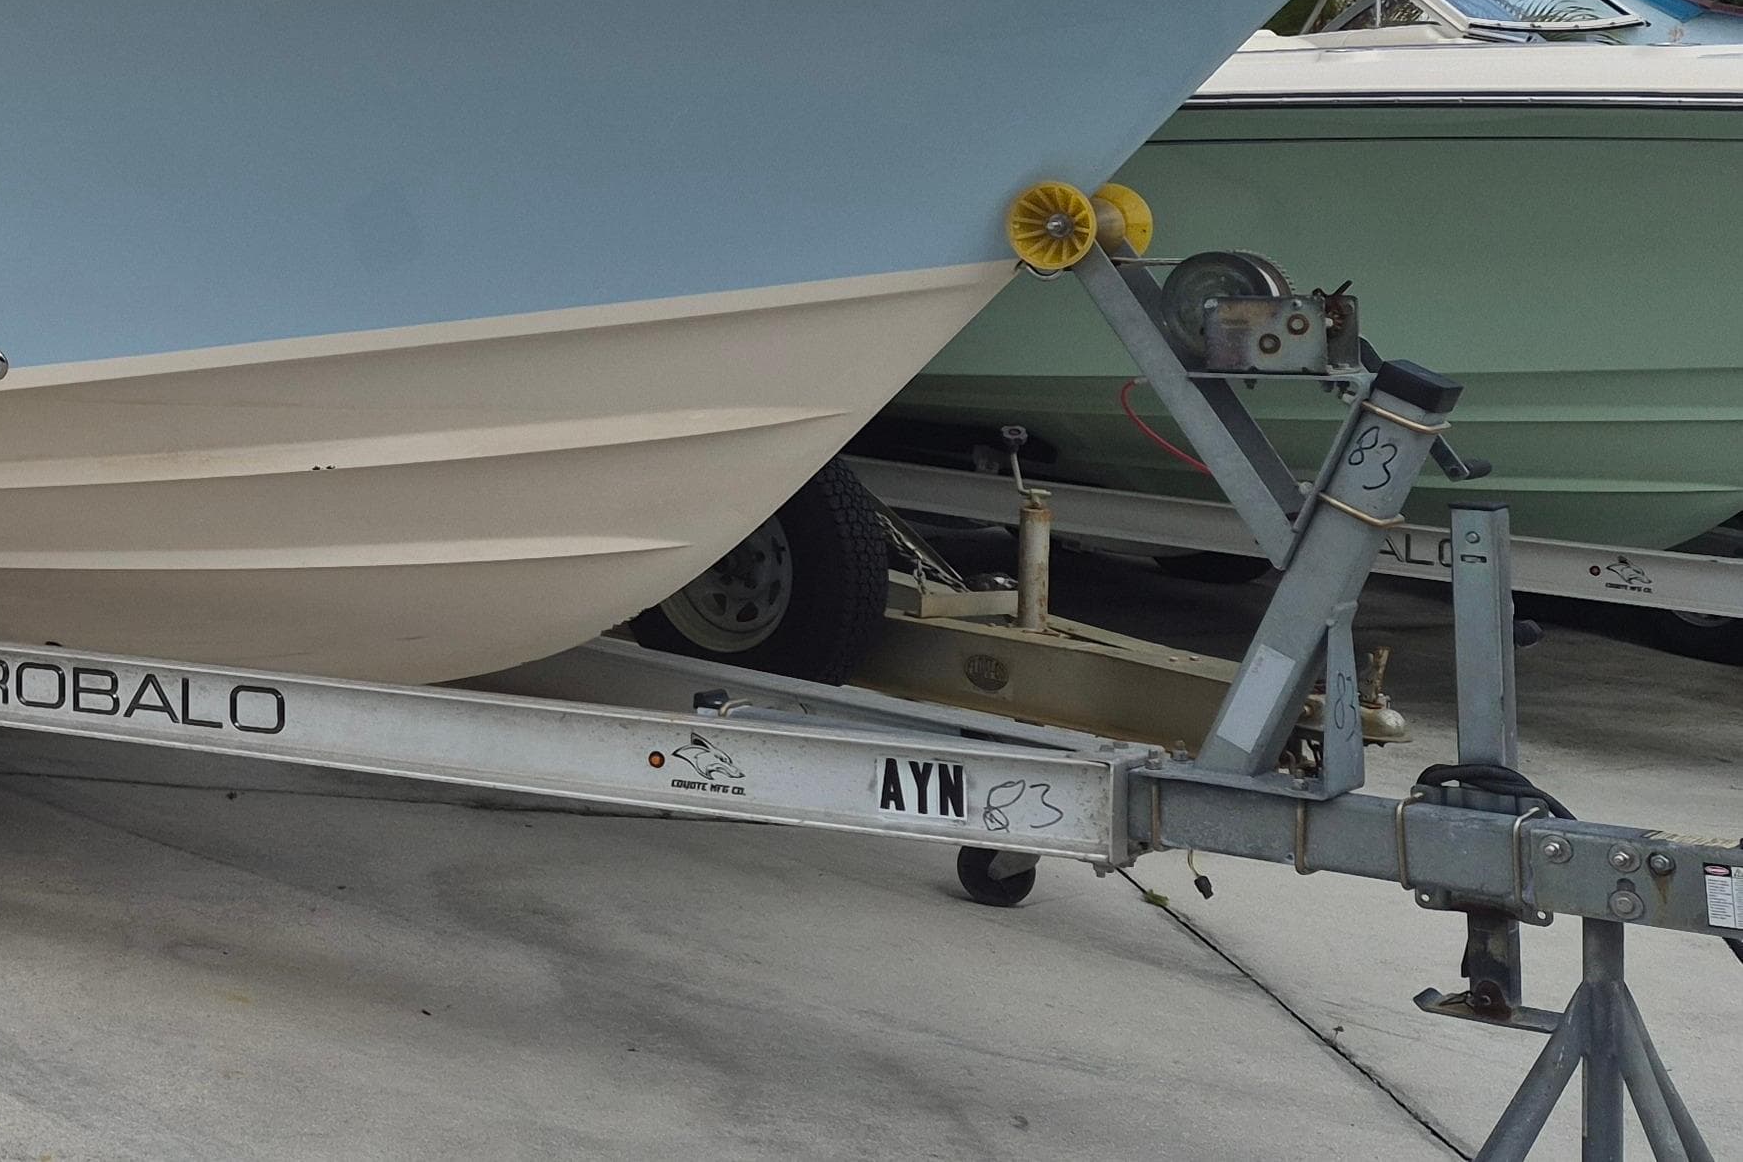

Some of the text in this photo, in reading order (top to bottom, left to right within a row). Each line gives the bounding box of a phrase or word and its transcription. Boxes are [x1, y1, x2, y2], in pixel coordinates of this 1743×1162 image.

[1348, 426, 1398, 491] 83
[671, 779, 708, 792] COYOTE
[710, 783, 730, 794] MFG
[880, 757, 965, 818] AYN
[983, 779, 1064, 833] 83
